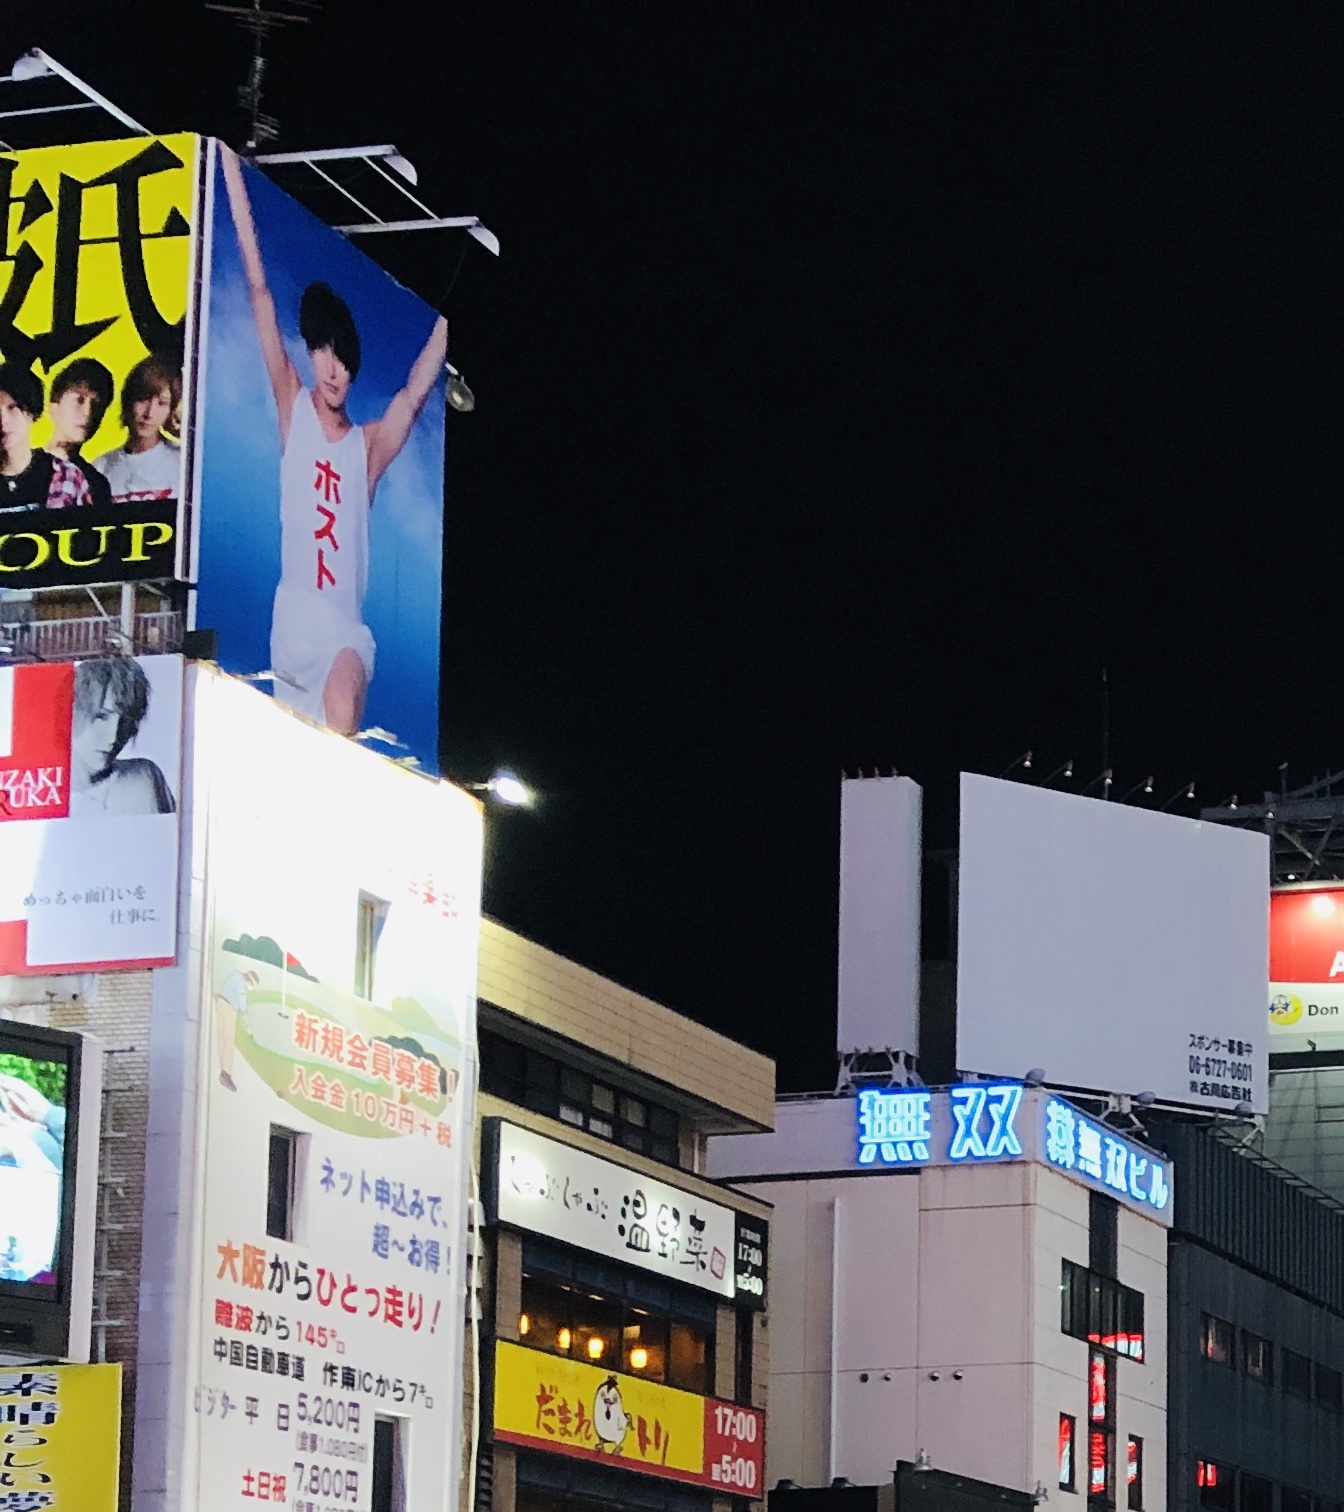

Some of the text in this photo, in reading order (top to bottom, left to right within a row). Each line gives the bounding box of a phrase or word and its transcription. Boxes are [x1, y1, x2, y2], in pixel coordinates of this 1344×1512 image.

[313, 460, 342, 590] ホスト
[0, 766, 62, 790] ZAKI
[1308, 1003, 1338, 1016] Don
[212, 1337, 306, 1381] 中国自動車道
[536, 1383, 594, 1442] だまれ
[637, 1414, 669, 1464] トリ
[714, 1404, 757, 1443] 17:00
[241, 1468, 286, 1502] 土日祝
